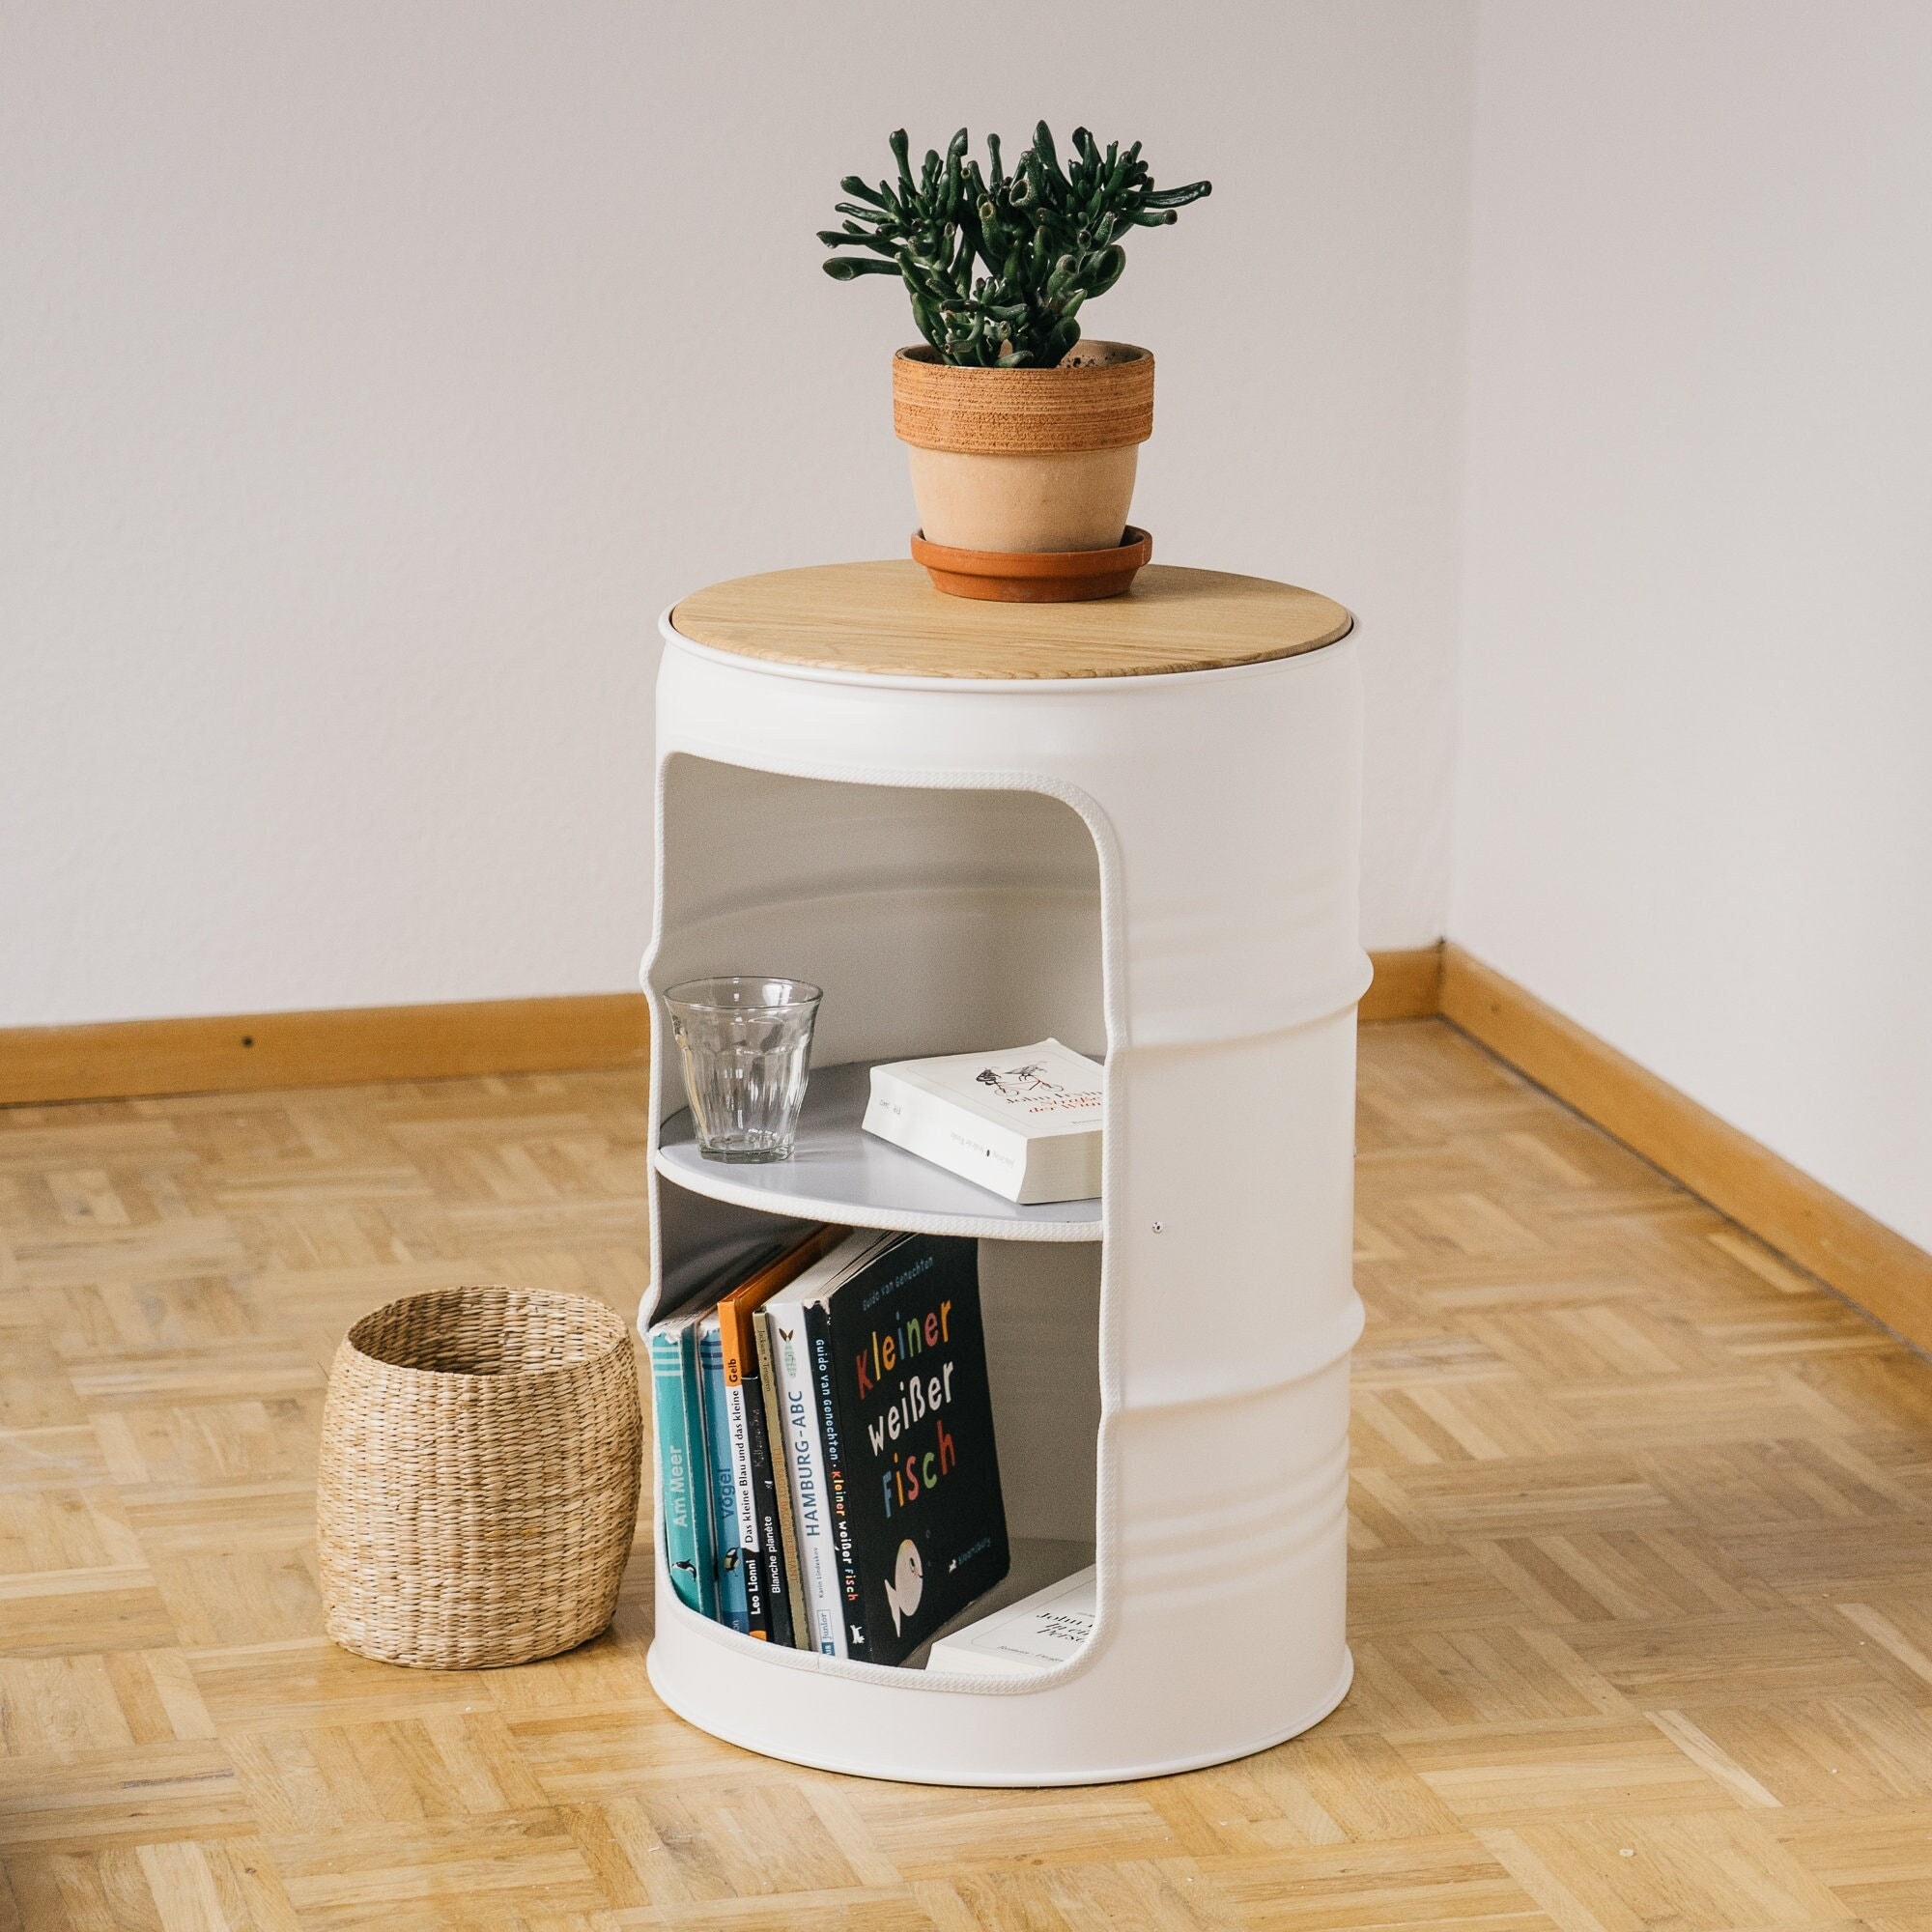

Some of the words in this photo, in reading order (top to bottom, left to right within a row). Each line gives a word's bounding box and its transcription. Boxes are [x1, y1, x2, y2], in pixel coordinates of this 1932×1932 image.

[815, 1339, 829, 1372] Guido
[855, 1299, 952, 1400] Kleiner
[727, 1358, 738, 1382] Gelb
[820, 1375, 831, 1396] van
[731, 1390, 742, 1421] kleine
[867, 1361, 953, 1457] weißer
[734, 1424, 744, 1440] das
[823, 1399, 838, 1461] Genechten
[669, 1444, 686, 1493] Meer
[735, 1442, 746, 1462] und
[788, 1390, 820, 1536] HAMBURG-ABC
[738, 1464, 748, 1487] Blau
[882, 1419, 955, 1519] Fisch
[741, 1490, 752, 1521] kleine
[831, 1470, 847, 1517] Kleiner
[673, 1496, 688, 1528] Am
[745, 1524, 753, 1543] Das
[764, 1516, 777, 1552] planète
[838, 1520, 853, 1564] weißer
[745, 1559, 758, 1592] Lionni
[769, 1554, 781, 1593] Blanche
[844, 1568, 859, 1601] Fisch
[751, 1595, 761, 1615] Leo
